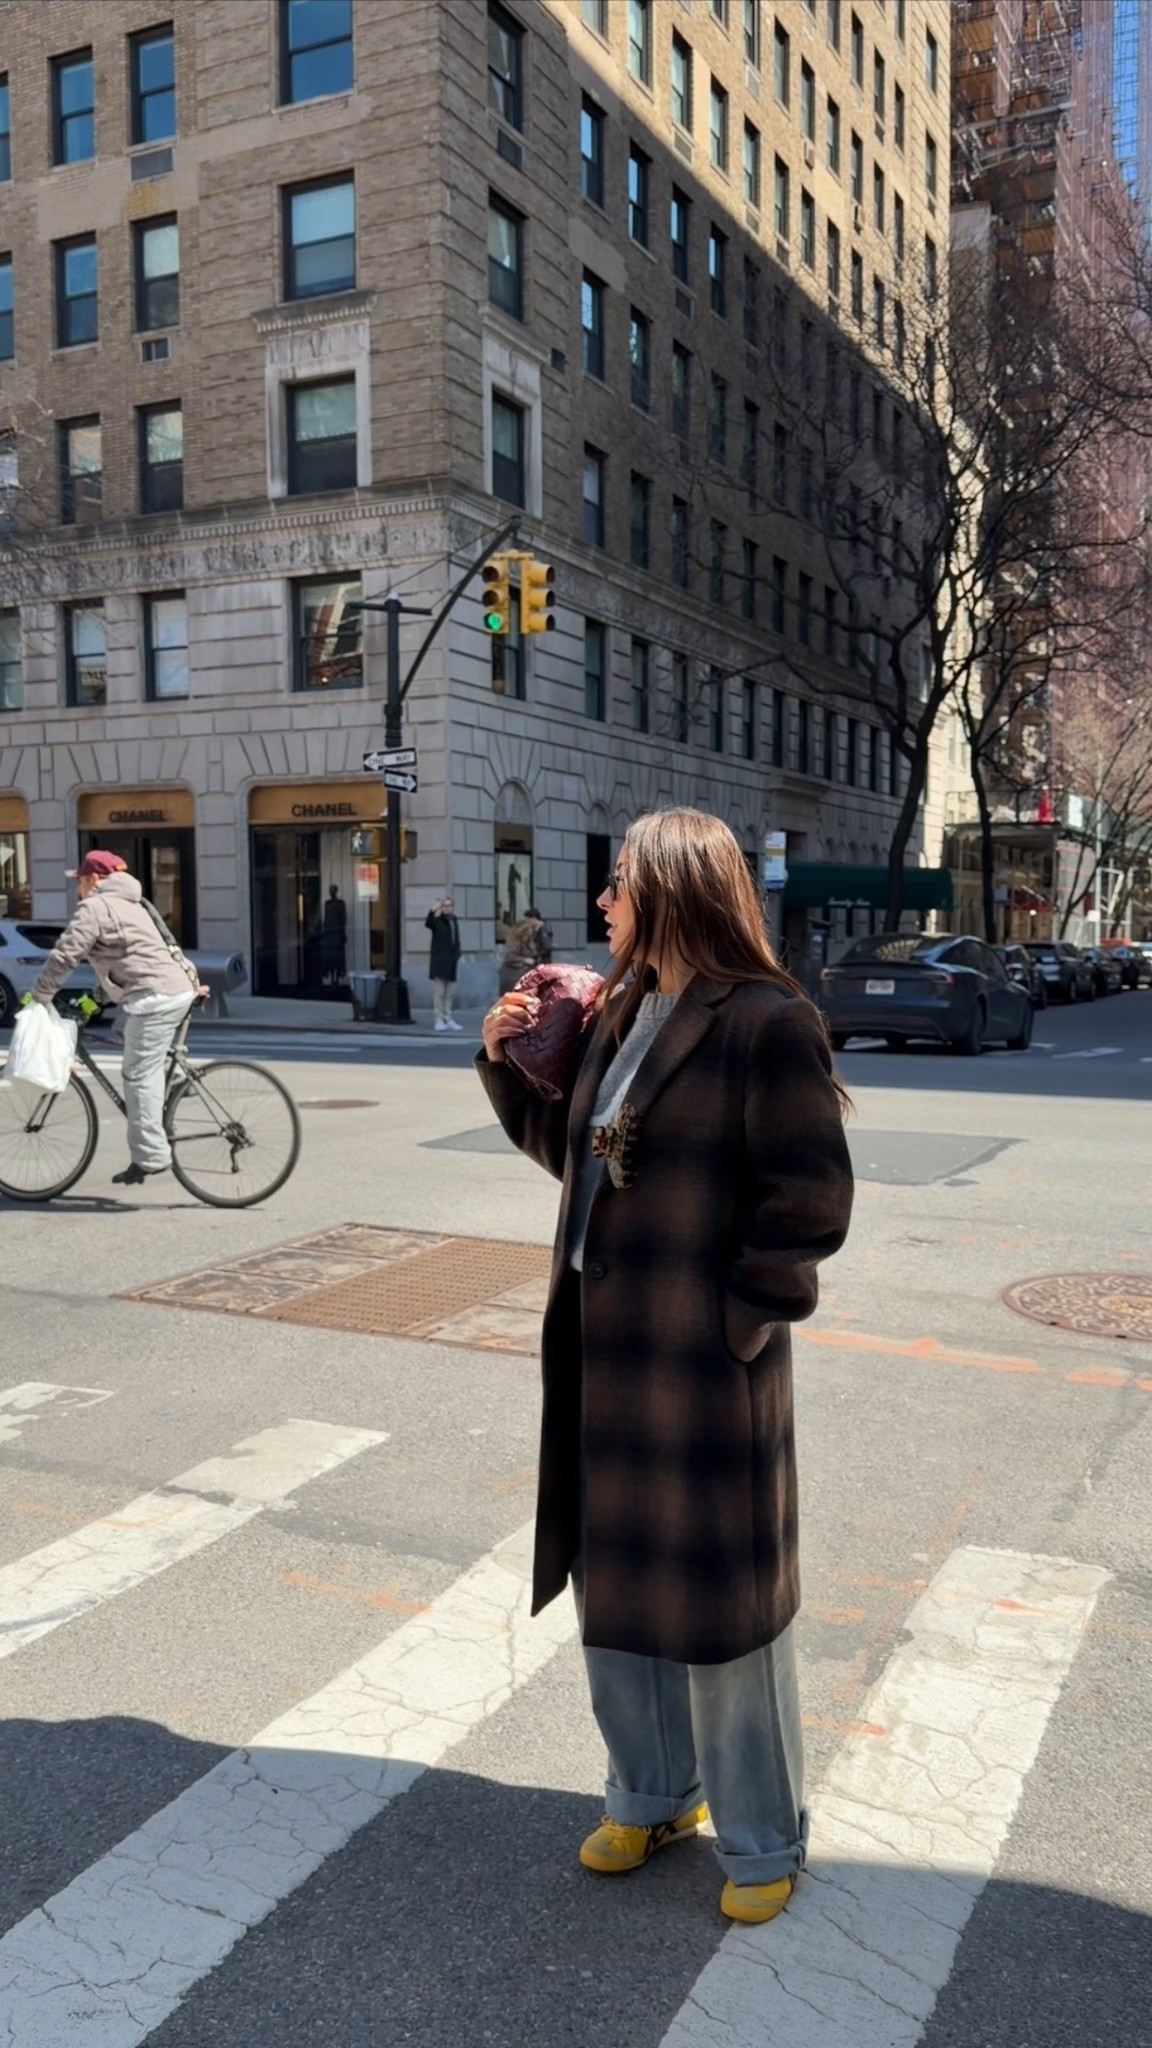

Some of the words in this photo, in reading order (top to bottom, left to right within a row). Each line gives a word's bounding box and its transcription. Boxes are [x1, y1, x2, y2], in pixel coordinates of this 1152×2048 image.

[369, 756, 384, 766] ONE
[396, 752, 412, 762] WAY
[108, 809, 169, 823] CHANEL
[291, 802, 358, 818] CHANEL
